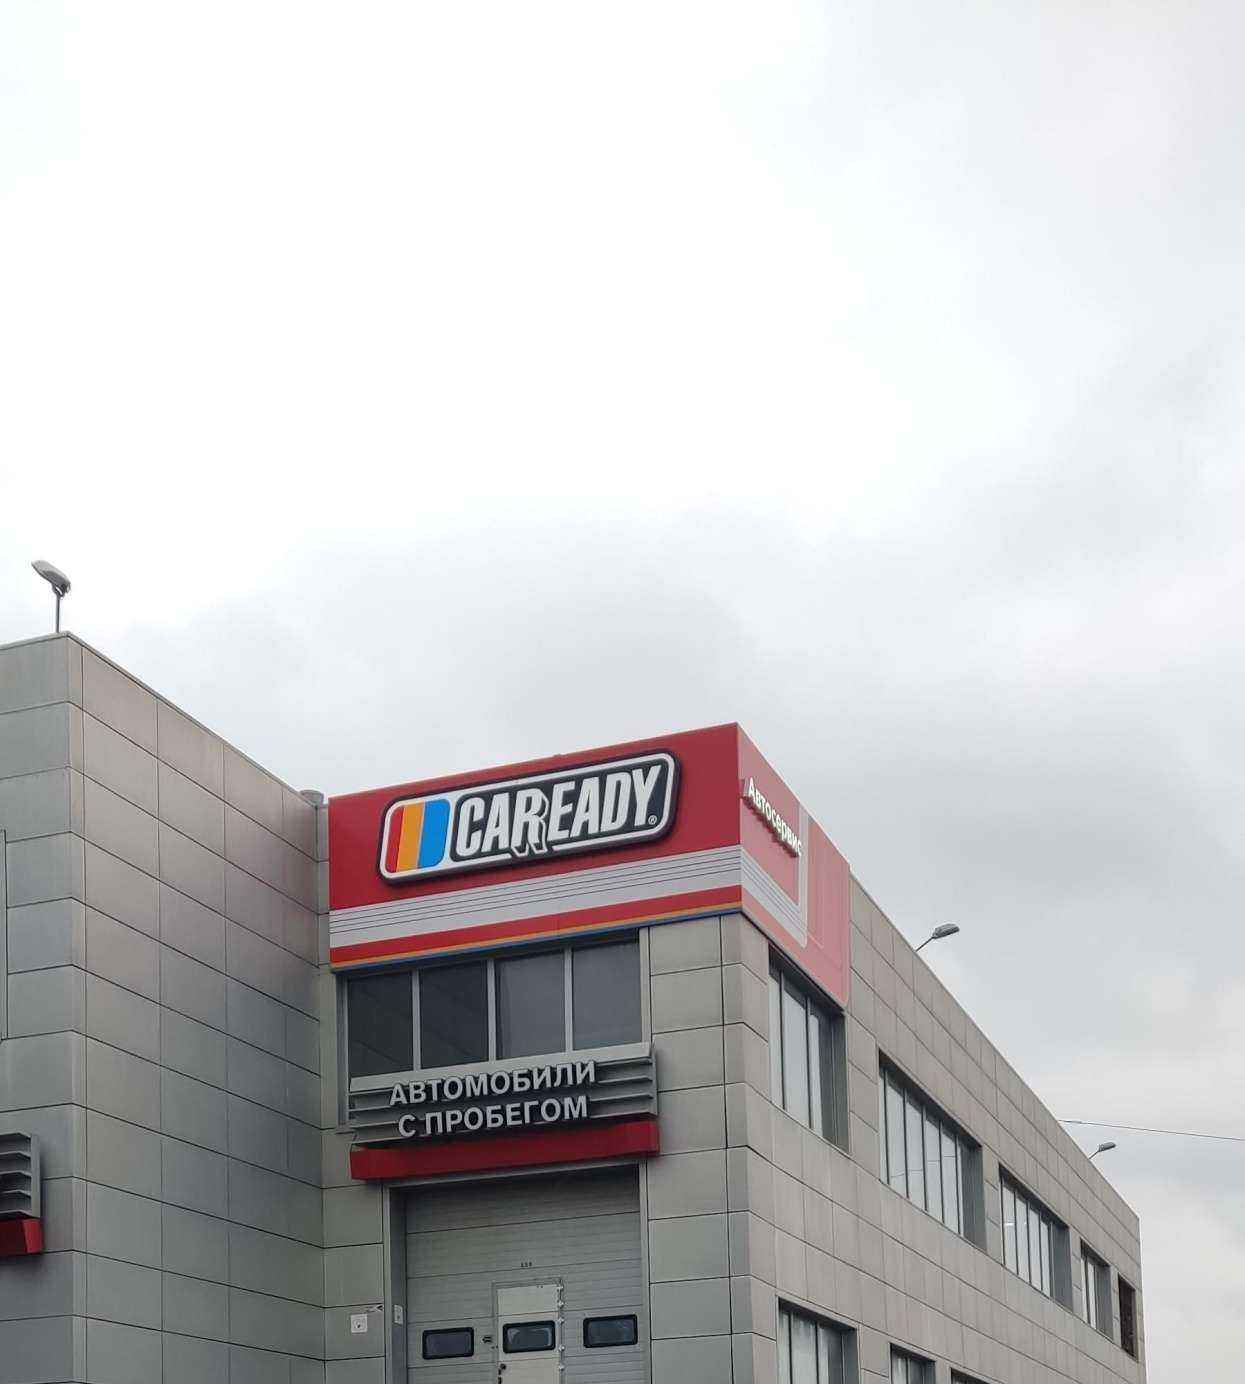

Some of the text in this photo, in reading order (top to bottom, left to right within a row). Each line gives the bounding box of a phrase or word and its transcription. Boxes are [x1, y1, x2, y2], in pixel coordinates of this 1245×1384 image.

[455, 765, 662, 857] CAREADY
[746, 777, 802, 855] Автосервис
[390, 1060, 596, 1106] АВТОМОБИЛИ
[398, 1095, 588, 1137] С ПРОБЕГОМ
